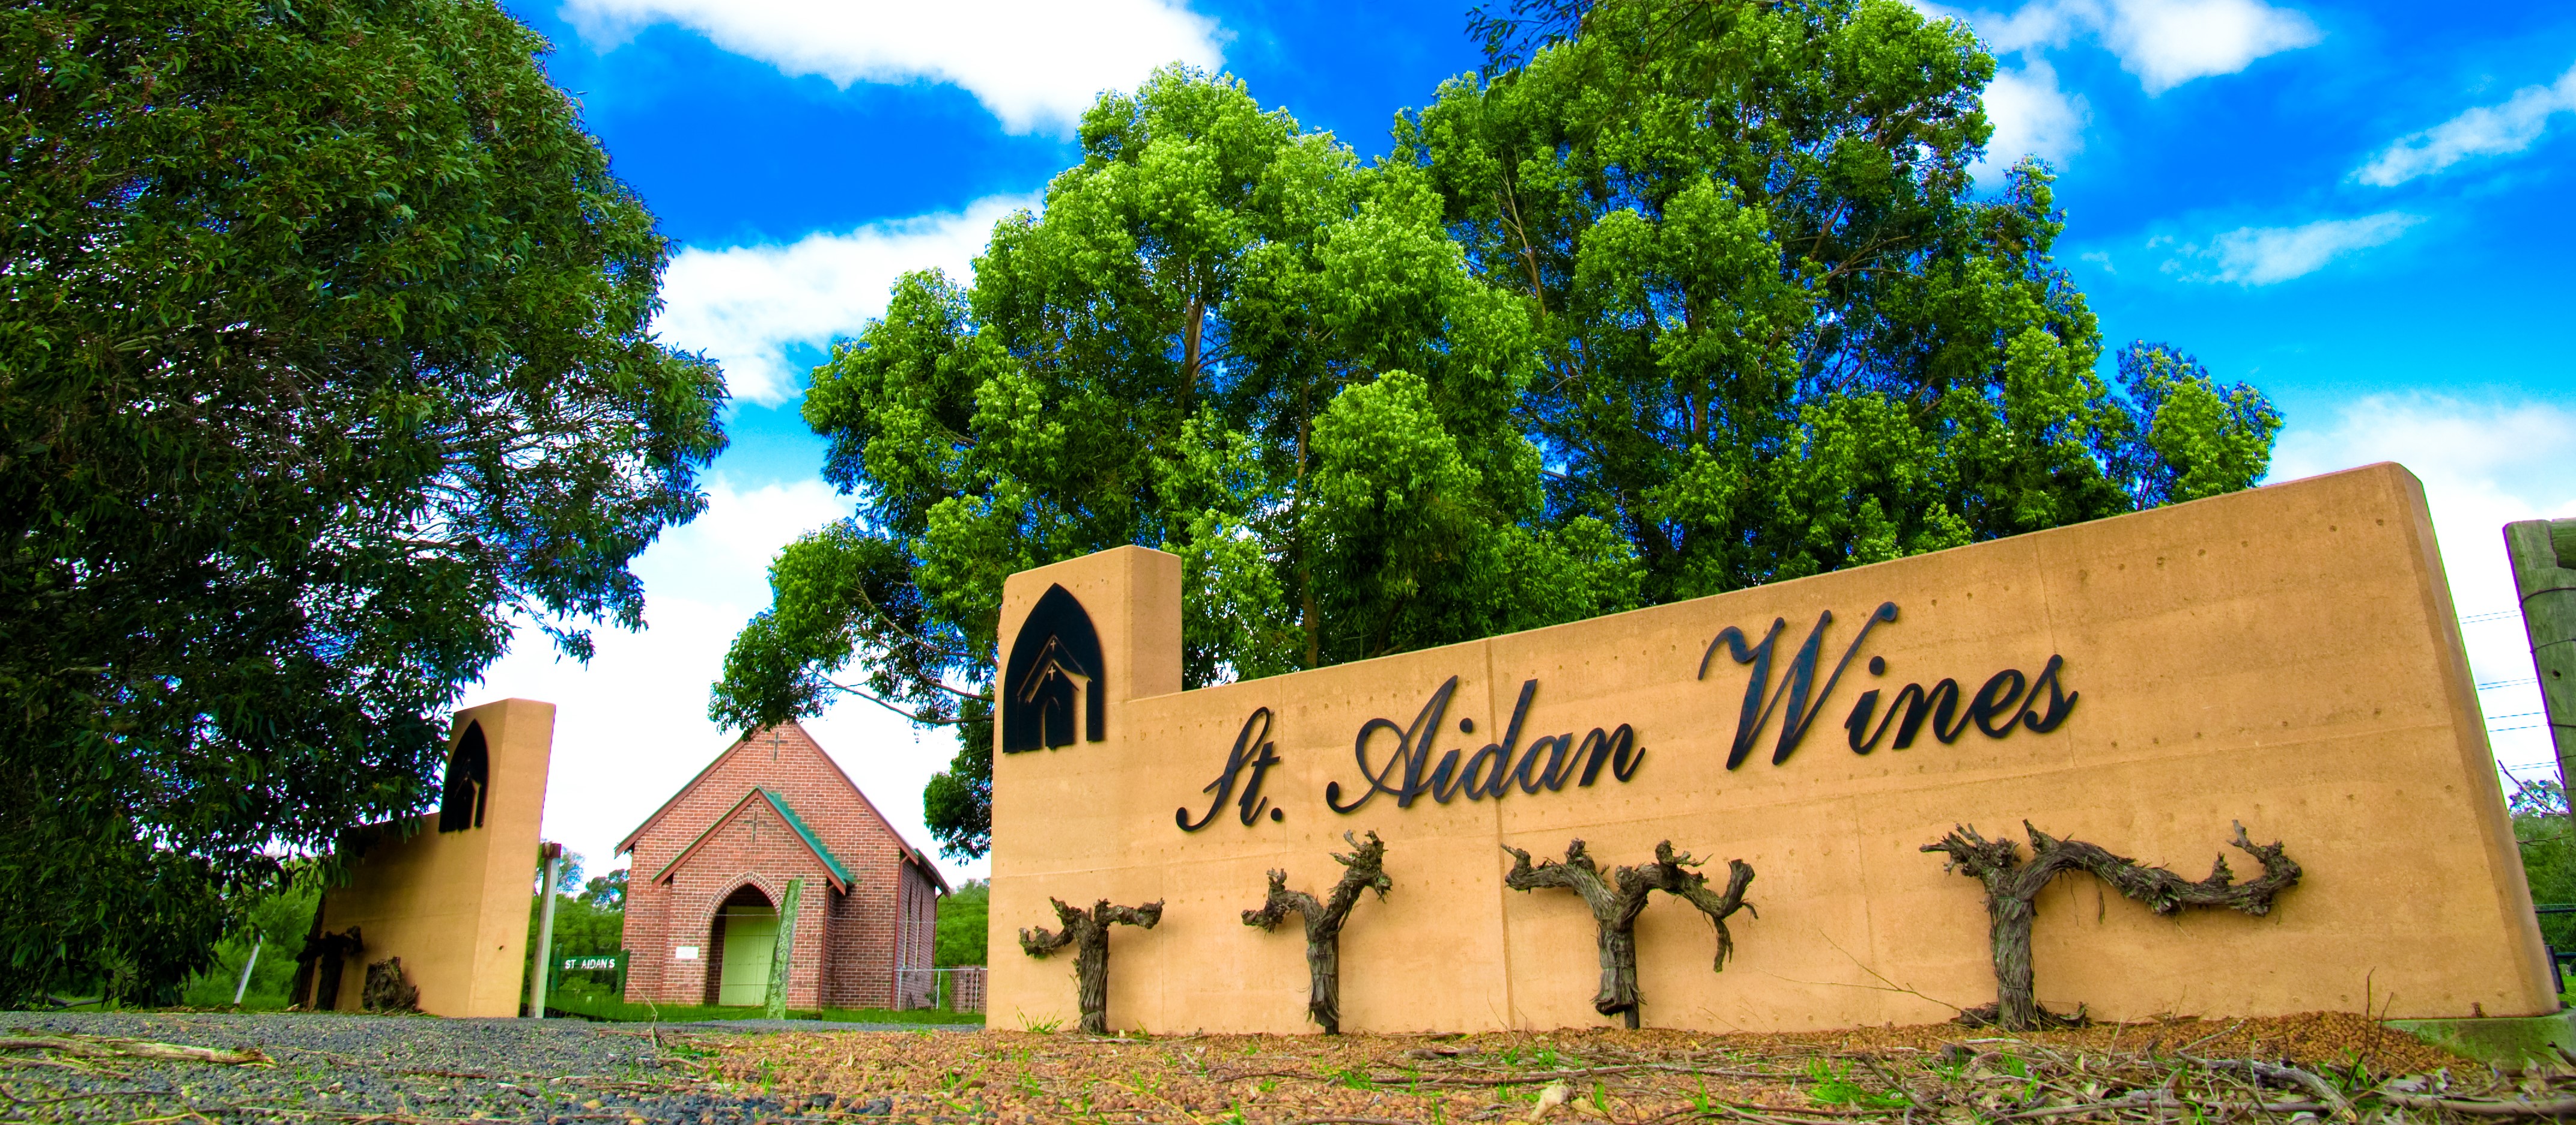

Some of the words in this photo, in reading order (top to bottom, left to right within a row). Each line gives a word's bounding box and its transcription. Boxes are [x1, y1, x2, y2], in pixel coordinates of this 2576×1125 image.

[1176, 706, 1283, 833] St.
[1326, 674, 1646, 815] Aidan
[1698, 602, 2079, 771] Wines
[565, 959, 576, 969] ST
[581, 958, 615, 969] AIDAN'S
